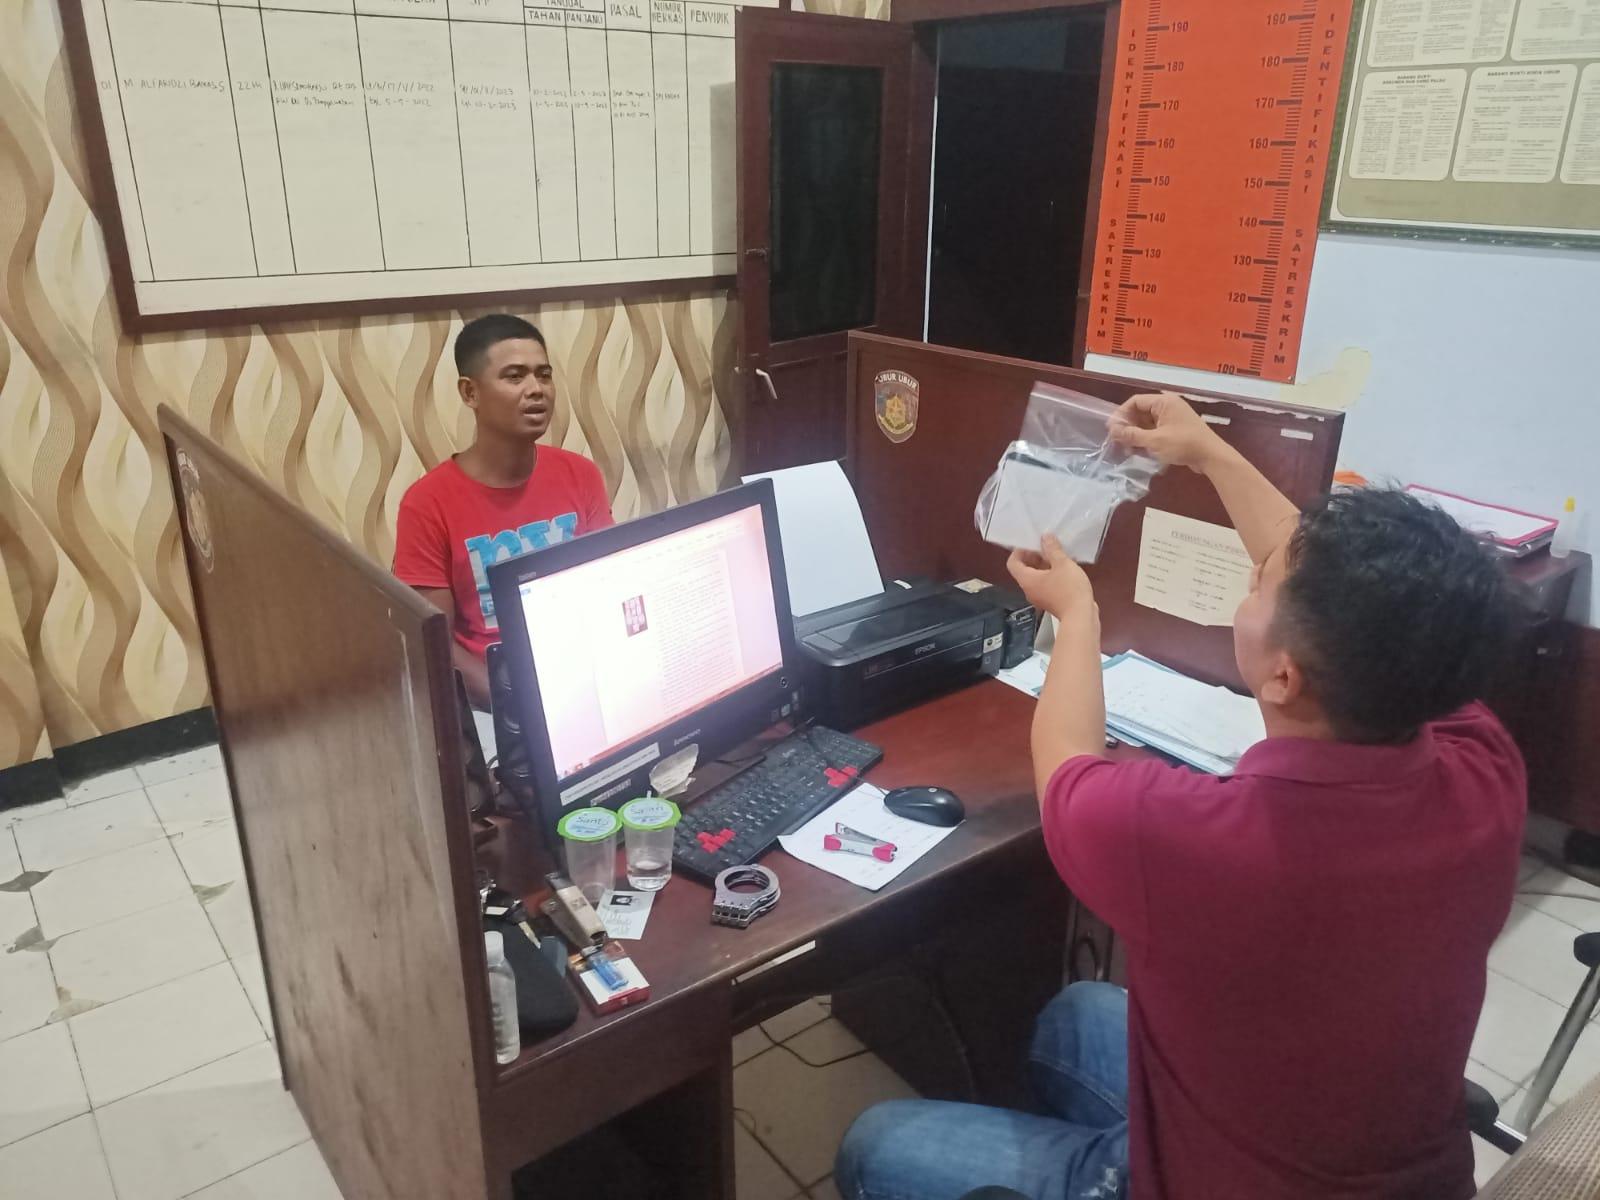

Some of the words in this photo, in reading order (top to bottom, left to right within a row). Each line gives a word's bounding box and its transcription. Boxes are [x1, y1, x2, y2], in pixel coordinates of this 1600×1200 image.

[528, 10, 561, 22] TAHAN
[610, 4, 642, 18] PASAL
[690, 10, 729, 25] PENYIDIK
[1267, 14, 1286, 24] 190
[1171, 22, 1189, 32] 190
[1167, 62, 1184, 71] 180
[1261, 56, 1281, 67] 180
[1162, 101, 1179, 111] 170
[1255, 98, 1274, 108] 170
[1304, 13, 1335, 194] IDENTIFIKASI
[1115, 29, 1136, 188] IDENTIFIKASI
[1158, 138, 1175, 148] 160
[1250, 138, 1268, 148] 160
[1153, 176, 1170, 186] 150
[1244, 178, 1263, 188] 150
[1149, 213, 1165, 223] 140
[1239, 217, 1257, 228] 140
[1145, 248, 1161, 258] 130
[1233, 255, 1251, 266] 130
[1097, 219, 1117, 338] SATRESKRIM
[1141, 283, 1156, 293] 120
[1228, 292, 1246, 303] 120
[1274, 228, 1303, 364] SATRESKRIM
[1137, 318, 1152, 328] 110
[1223, 329, 1240, 339] 110
[1133, 351, 1148, 360] 100
[1217, 364, 1235, 374] 100
